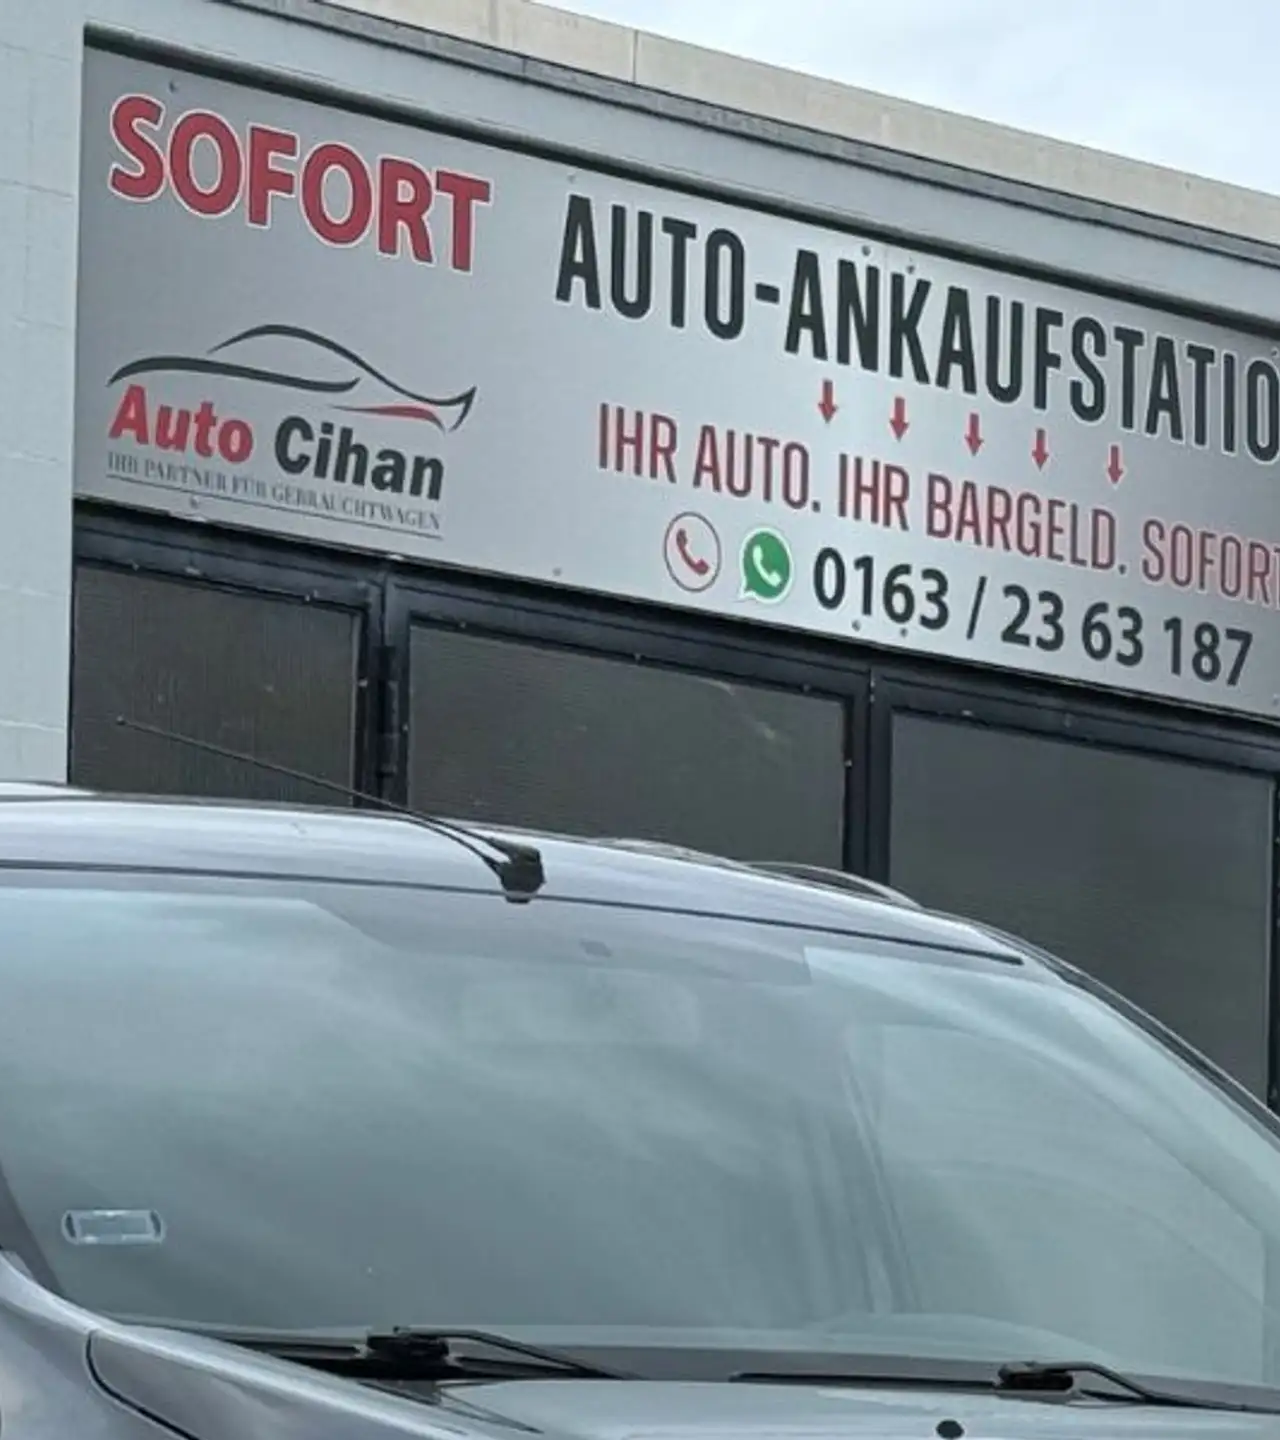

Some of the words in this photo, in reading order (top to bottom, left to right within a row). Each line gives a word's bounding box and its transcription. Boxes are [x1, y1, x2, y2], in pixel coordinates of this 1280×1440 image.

[109, 94, 491, 273] SOFORT
[108, 452, 138, 474] IHR
[145, 457, 227, 492] PARTNER
[272, 481, 442, 531] GEBRAUCHTWAGEN
[109, 384, 254, 464] Auto
[274, 411, 444, 500] Cihan
[599, 402, 679, 483] IHR
[692, 424, 821, 512] AUTO.
[837, 453, 910, 531] IHR
[925, 472, 1128, 577] BARGELD.
[812, 547, 950, 631] 0163
[966, 575, 987, 639] /
[1000, 583, 1064, 651] 23
[1080, 600, 1144, 667] 63
[1162, 617, 1253, 686] 187
